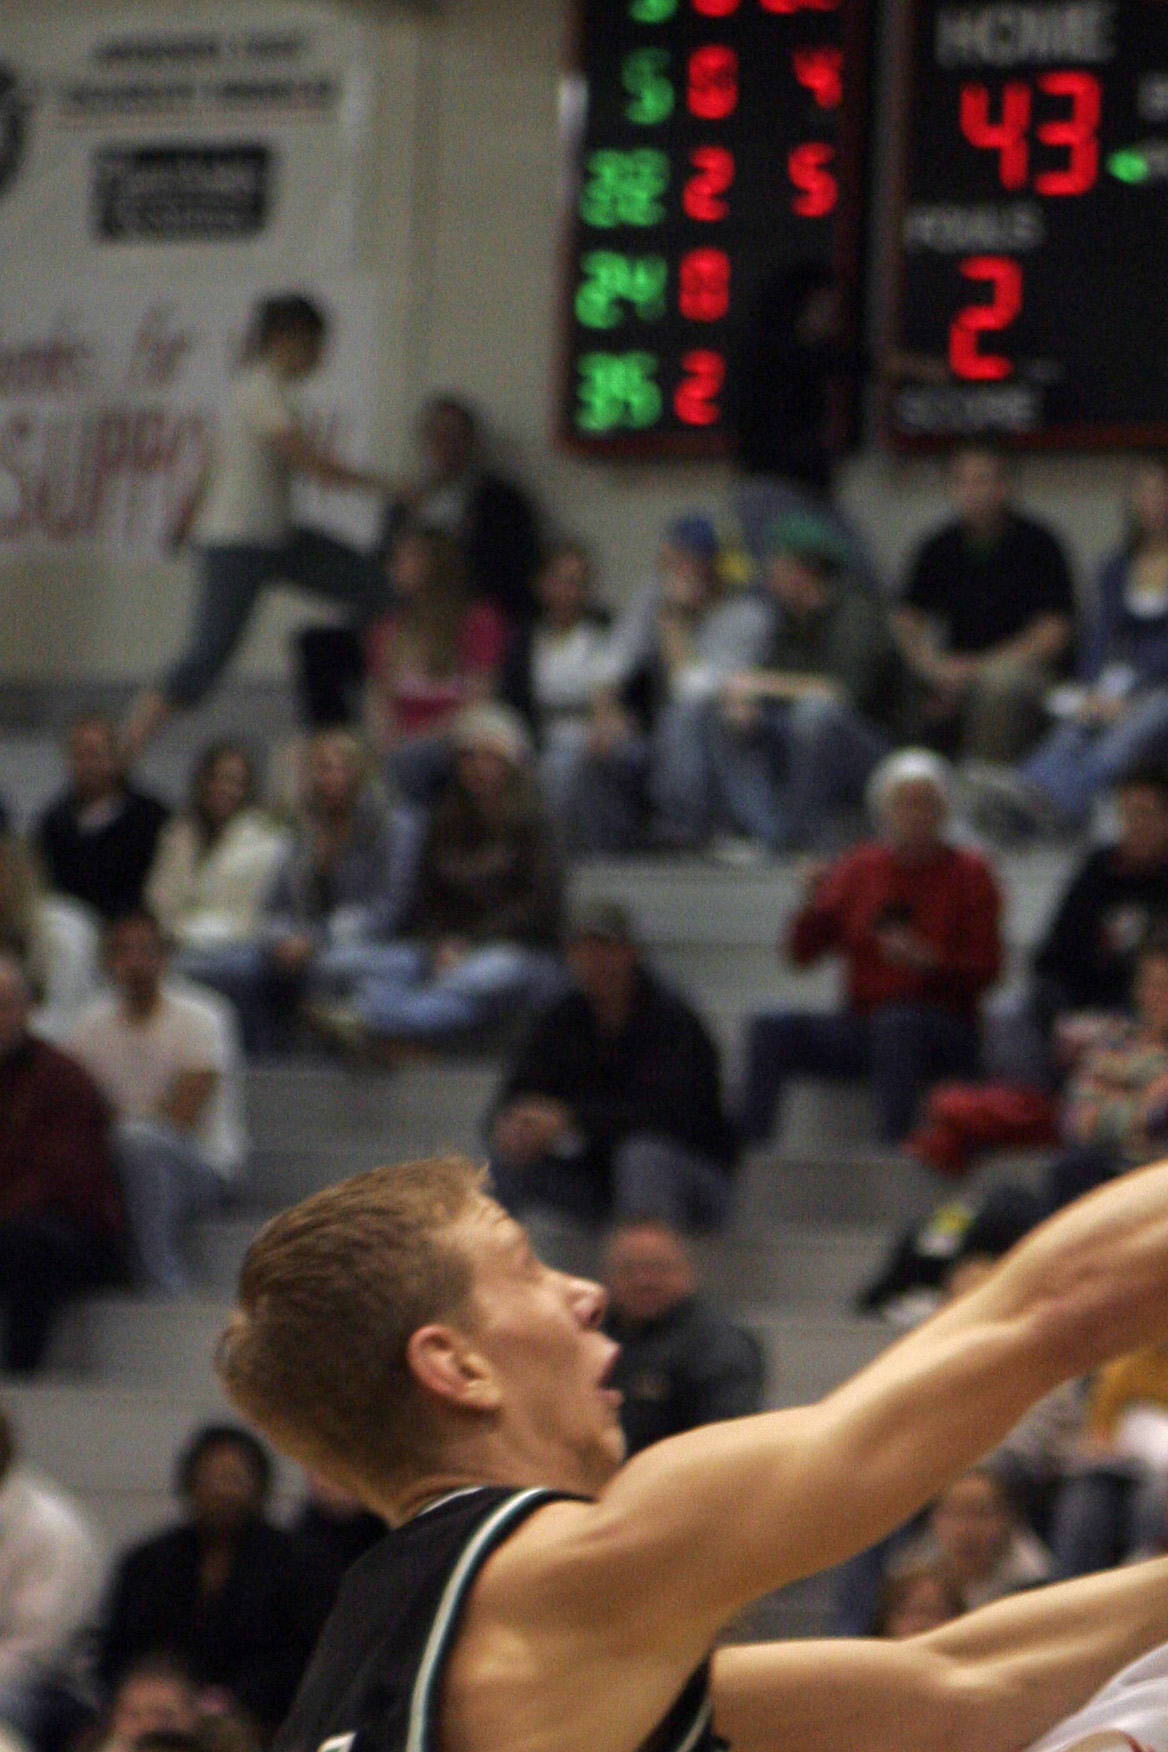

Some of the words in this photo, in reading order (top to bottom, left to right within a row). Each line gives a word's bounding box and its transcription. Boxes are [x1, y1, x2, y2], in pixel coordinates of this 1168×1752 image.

[938, 7, 1110, 66] HOME
[960, 70, 1101, 195] 43
[683, 146, 734, 221] 2
[788, 142, 838, 217] 5
[950, 255, 1023, 381] 2
[674, 349, 725, 425] 2
